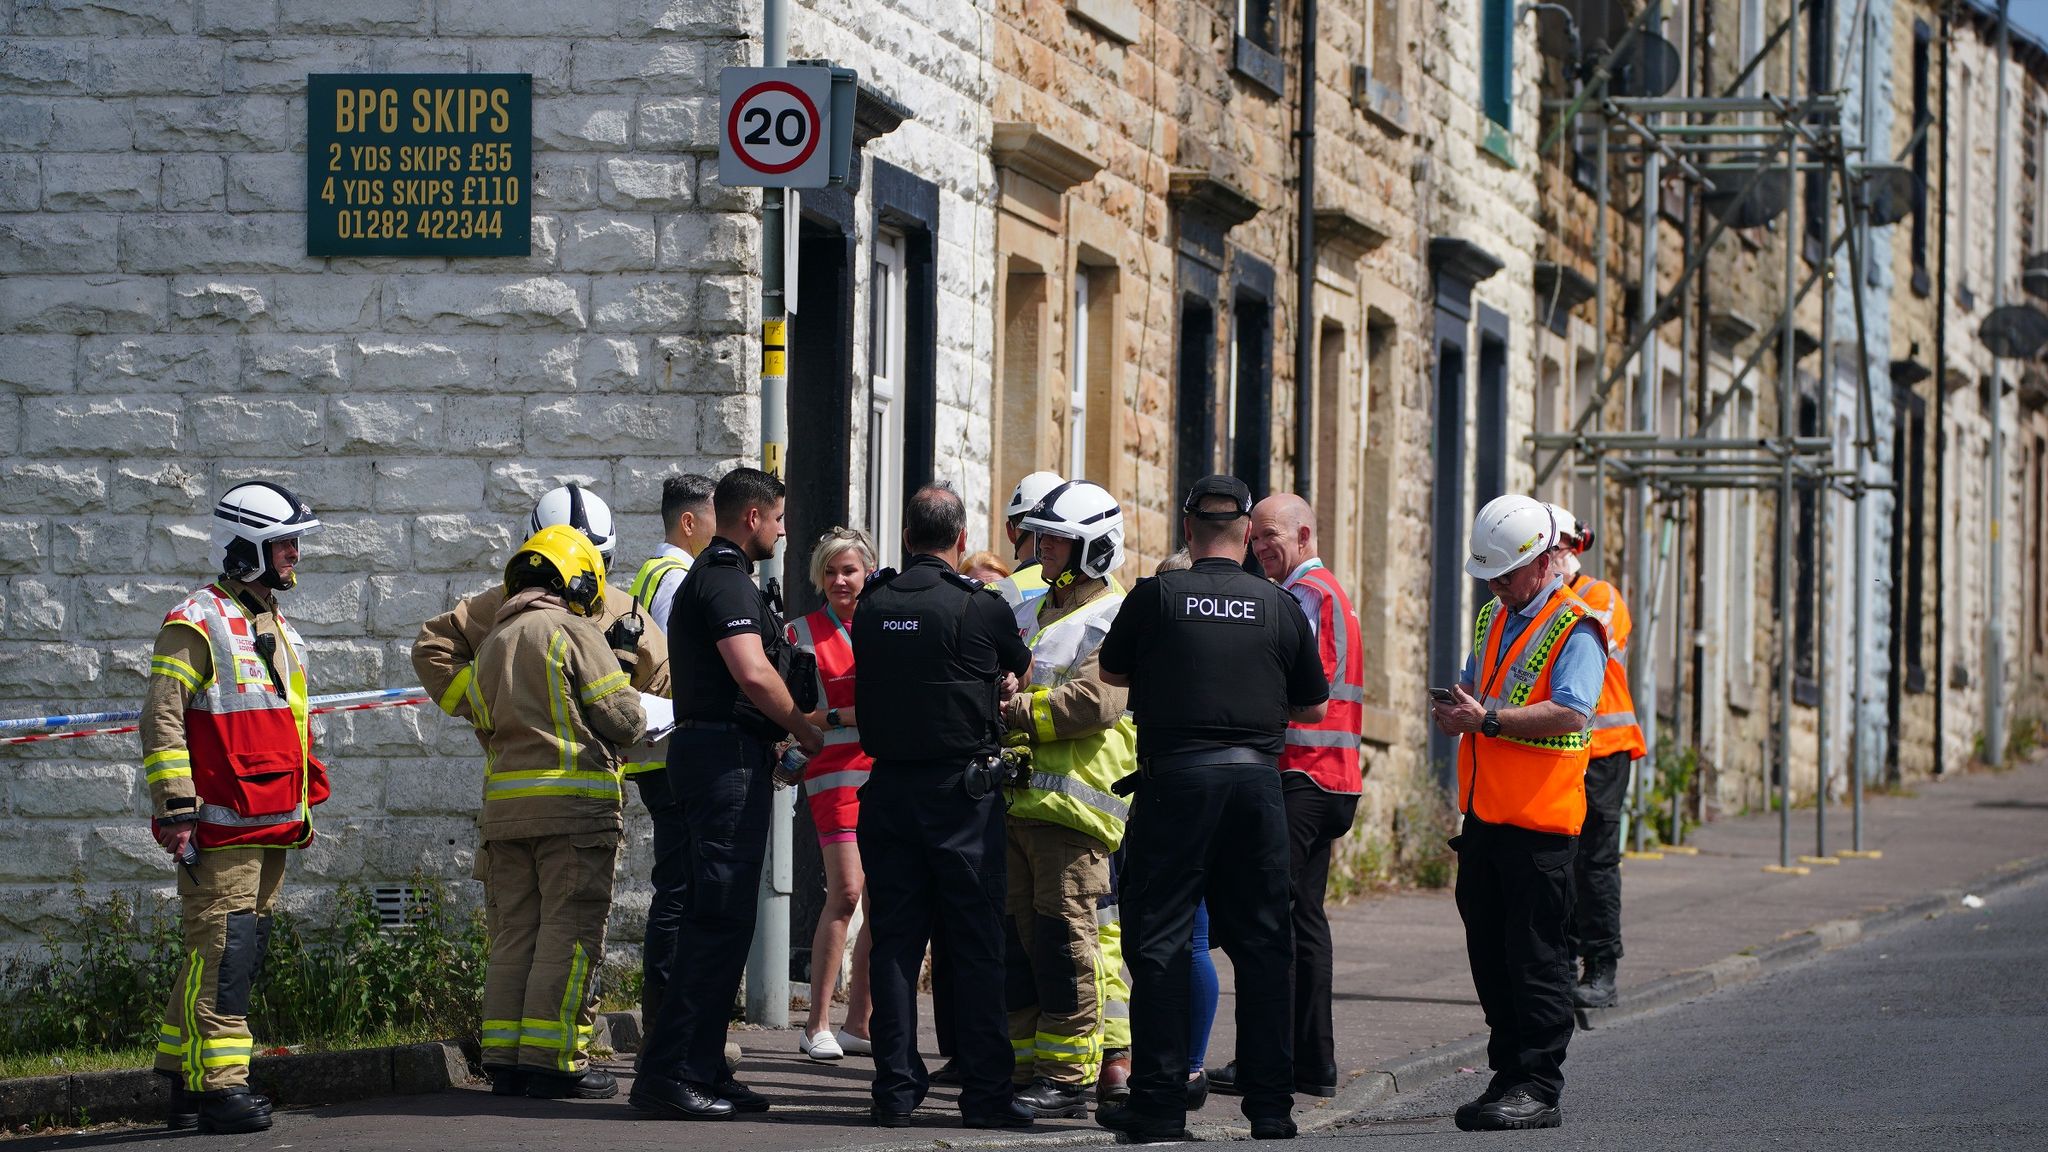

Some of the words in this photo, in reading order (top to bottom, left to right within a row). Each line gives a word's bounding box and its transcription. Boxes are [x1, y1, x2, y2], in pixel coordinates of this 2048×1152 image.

[336, 88, 398, 133] BPG
[412, 88, 510, 133] SKIPS
[744, 107, 806, 147] 20
[329, 143, 342, 171] 2
[351, 146, 392, 172] YDS
[399, 146, 461, 172] SKIPS
[469, 143, 512, 171] £55
[321, 177, 335, 205] 4
[343, 180, 384, 205] YDS
[392, 179, 454, 205] SKIPS
[462, 177, 519, 205] £110
[338, 209, 409, 238] 01282
[416, 210, 503, 238] 422344
[1187, 597, 1256, 619] POLICE
[727, 619, 752, 628] POLICE
[883, 620, 919, 630] POLICE
